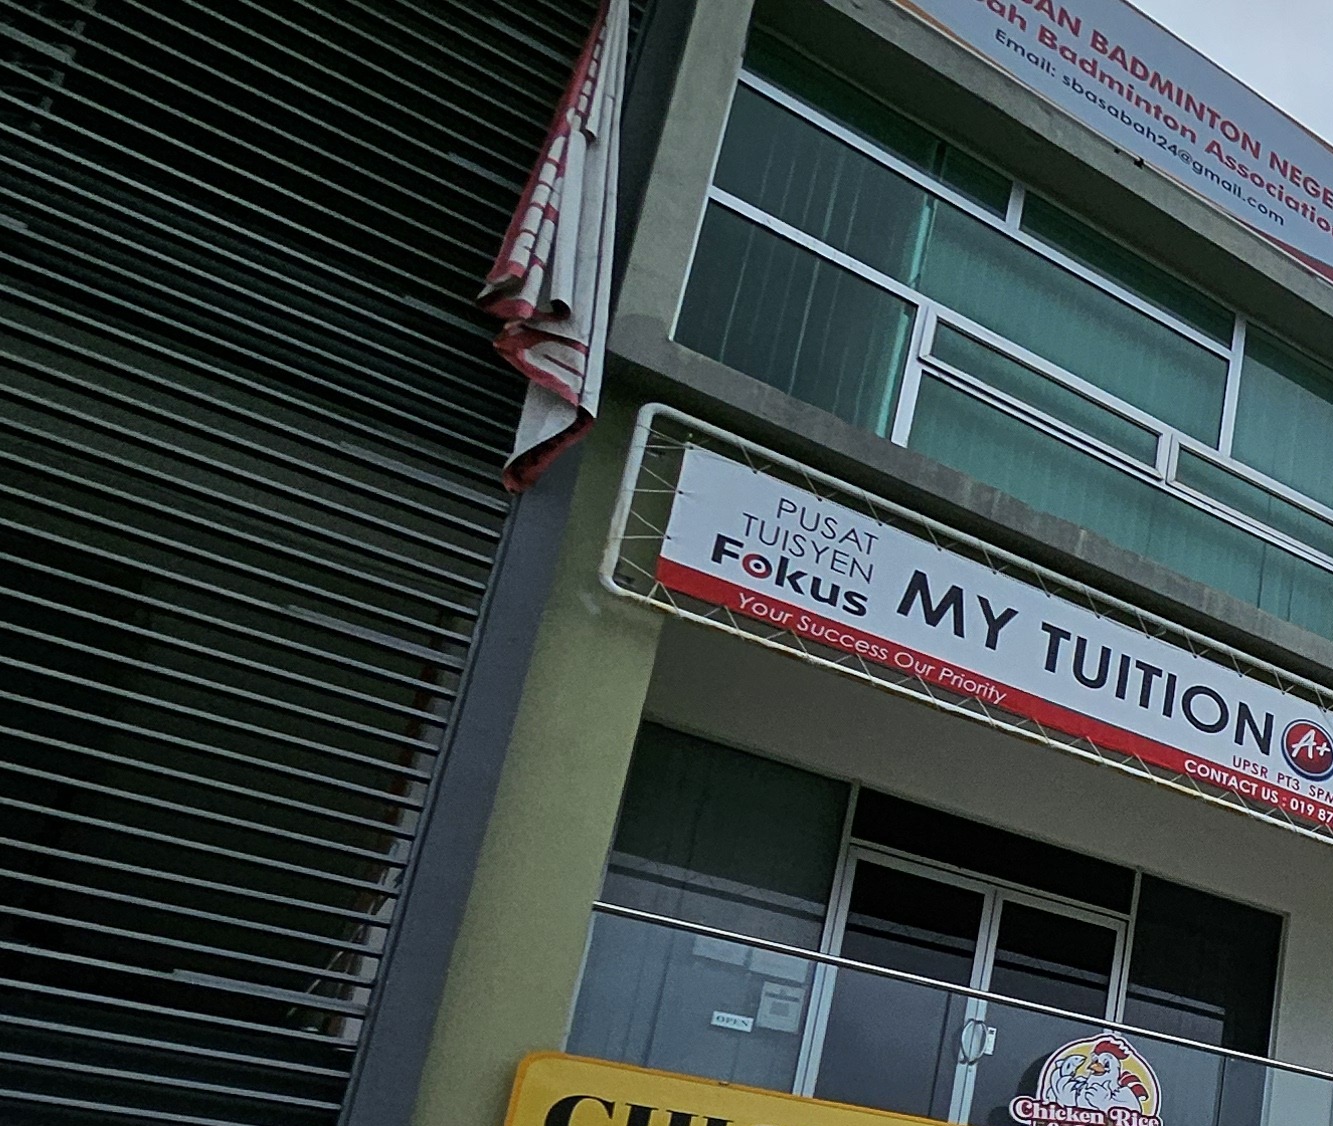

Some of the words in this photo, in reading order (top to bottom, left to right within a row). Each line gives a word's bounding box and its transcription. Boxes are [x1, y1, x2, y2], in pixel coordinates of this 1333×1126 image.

[1037, 23, 1198, 145] Badminton
[1090, 29, 1262, 160] BADMINTON
[995, 28, 1057, 78] Email:
[1062, 74, 1285, 226] sbasabah24@gmail.com
[742, 512, 874, 584] TUISYEN
[777, 497, 879, 557] PUSAT
[739, 592, 793, 626] Your
[797, 614, 889, 662] Success
[894, 651, 935, 678] Our
[938, 667, 1007, 704] Priority
[896, 570, 1019, 652] MY
[1041, 621, 1275, 758] TUITION
[1184, 759, 1258, 796] CONTACT
[1262, 786, 1279, 803] US
[1290, 799, 1315, 816] 019
[1232, 755, 1268, 779] UPSR
[1277, 773, 1300, 791] PT3
[716, 1015, 748, 1027] OPEN
[1015, 1099, 1105, 1125] Chicken
